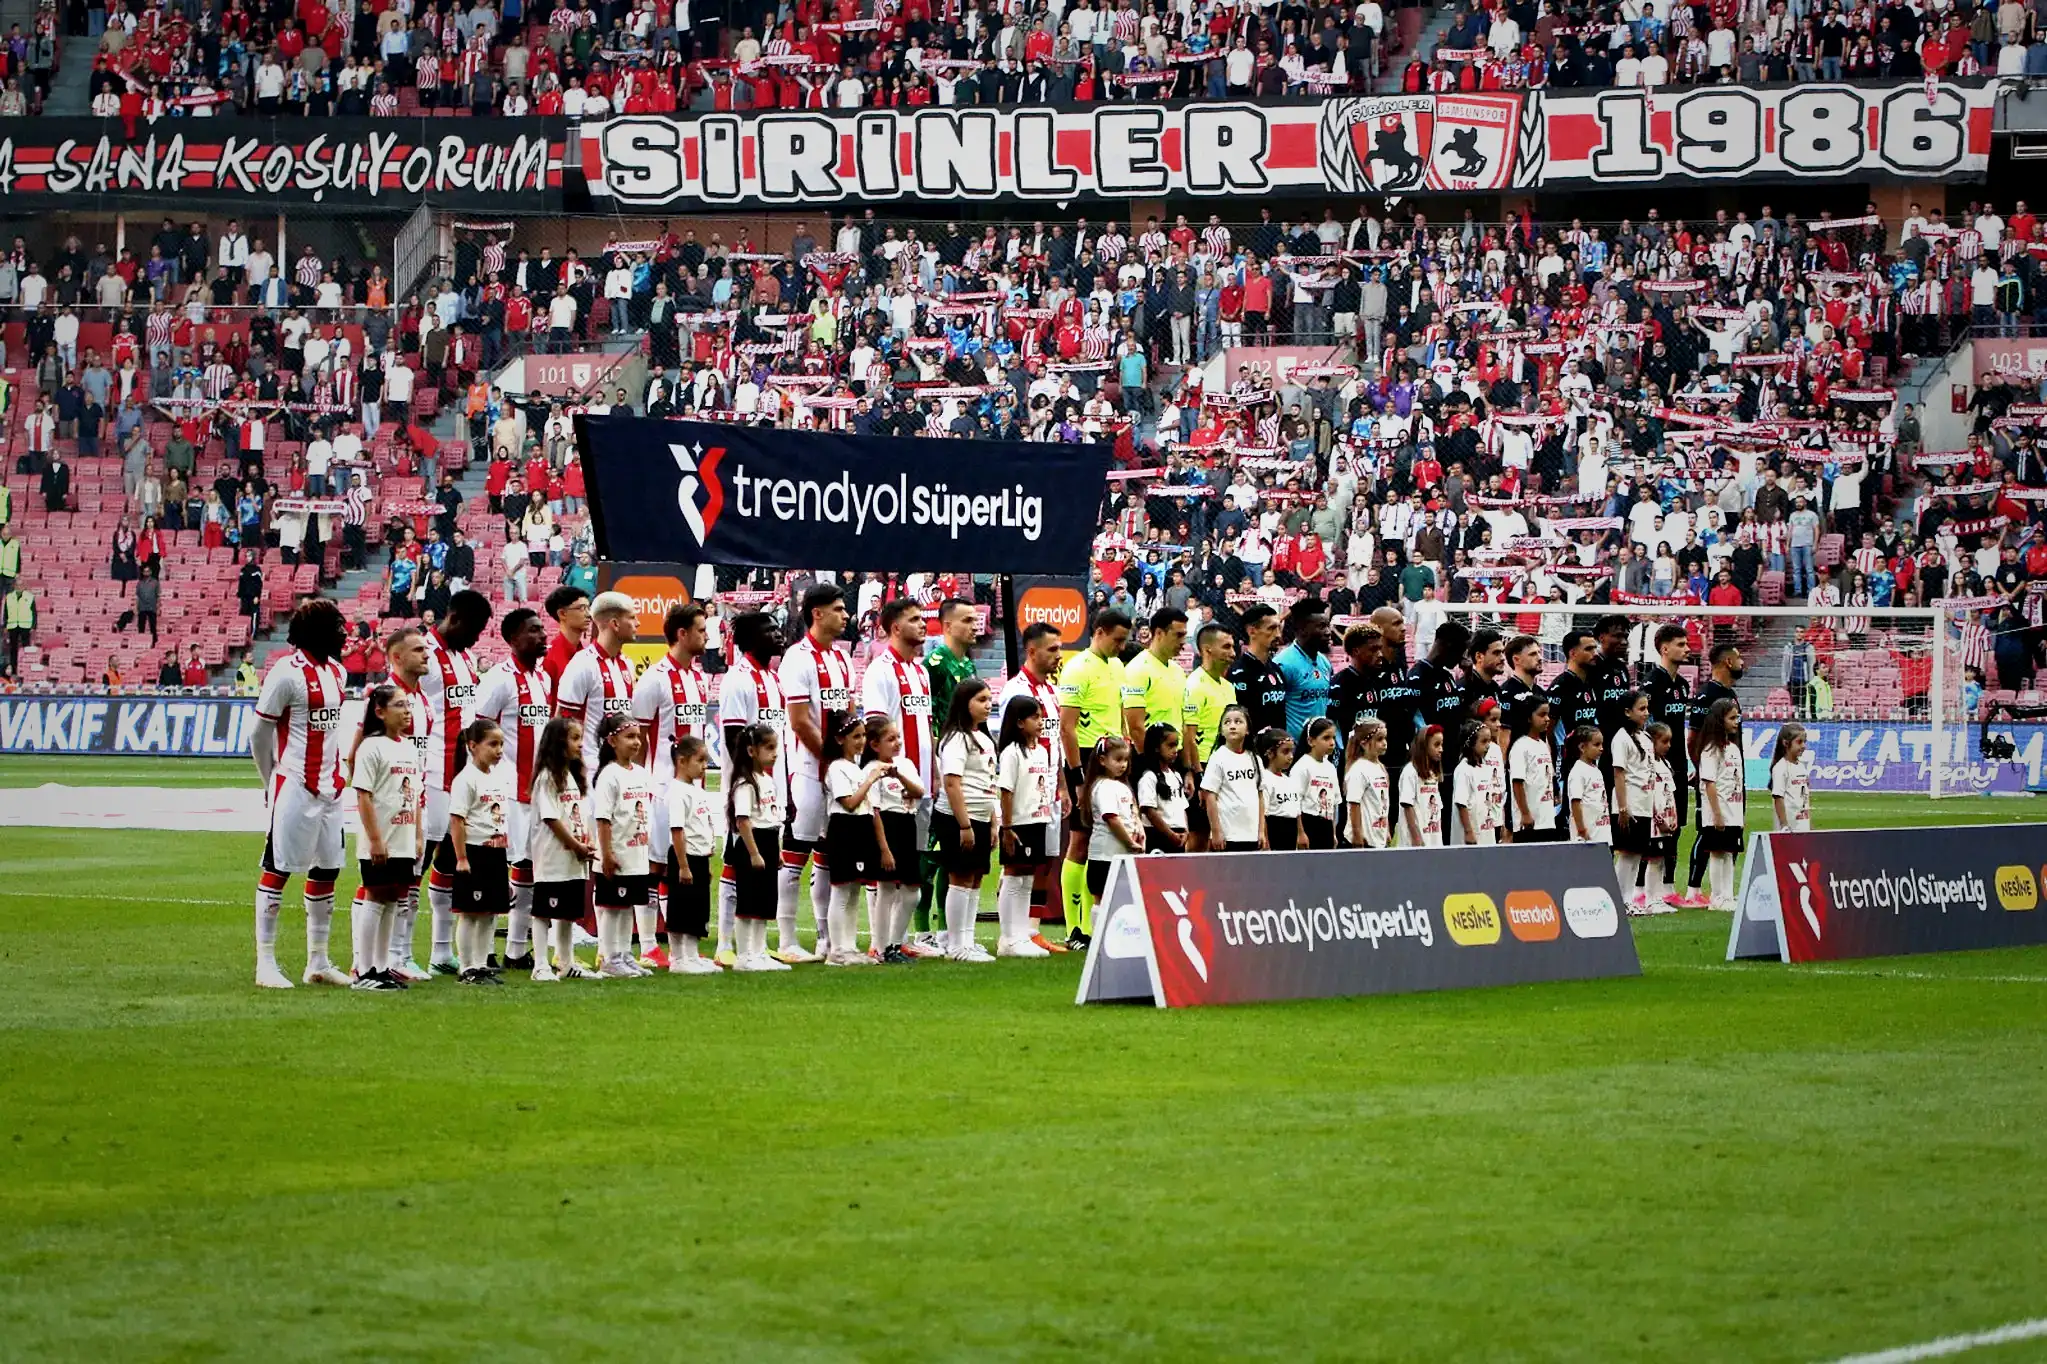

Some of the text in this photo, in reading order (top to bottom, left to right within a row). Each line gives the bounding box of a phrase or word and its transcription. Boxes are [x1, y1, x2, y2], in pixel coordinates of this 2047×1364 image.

[1439, 103, 1506, 121] SAMSUNSPOR
[1593, 84, 1966, 179] 1986
[47, 132, 188, 193] SANA
[216, 130, 548, 202] KOŞUYORUM
[539, 366, 567, 384] 101
[733, 464, 906, 535] trendyol
[1024, 603, 1081, 627] trendyol
[1618, 593, 1687, 606] SAMSUNSPOR
[448, 685, 476, 699] CORE
[0, 702, 108, 750] VAKIF
[520, 705, 550, 718] CORE
[1830, 867, 1919, 914] trendyol
[1217, 896, 1341, 951] trendyol
[1509, 904, 1556, 926] trendyol
